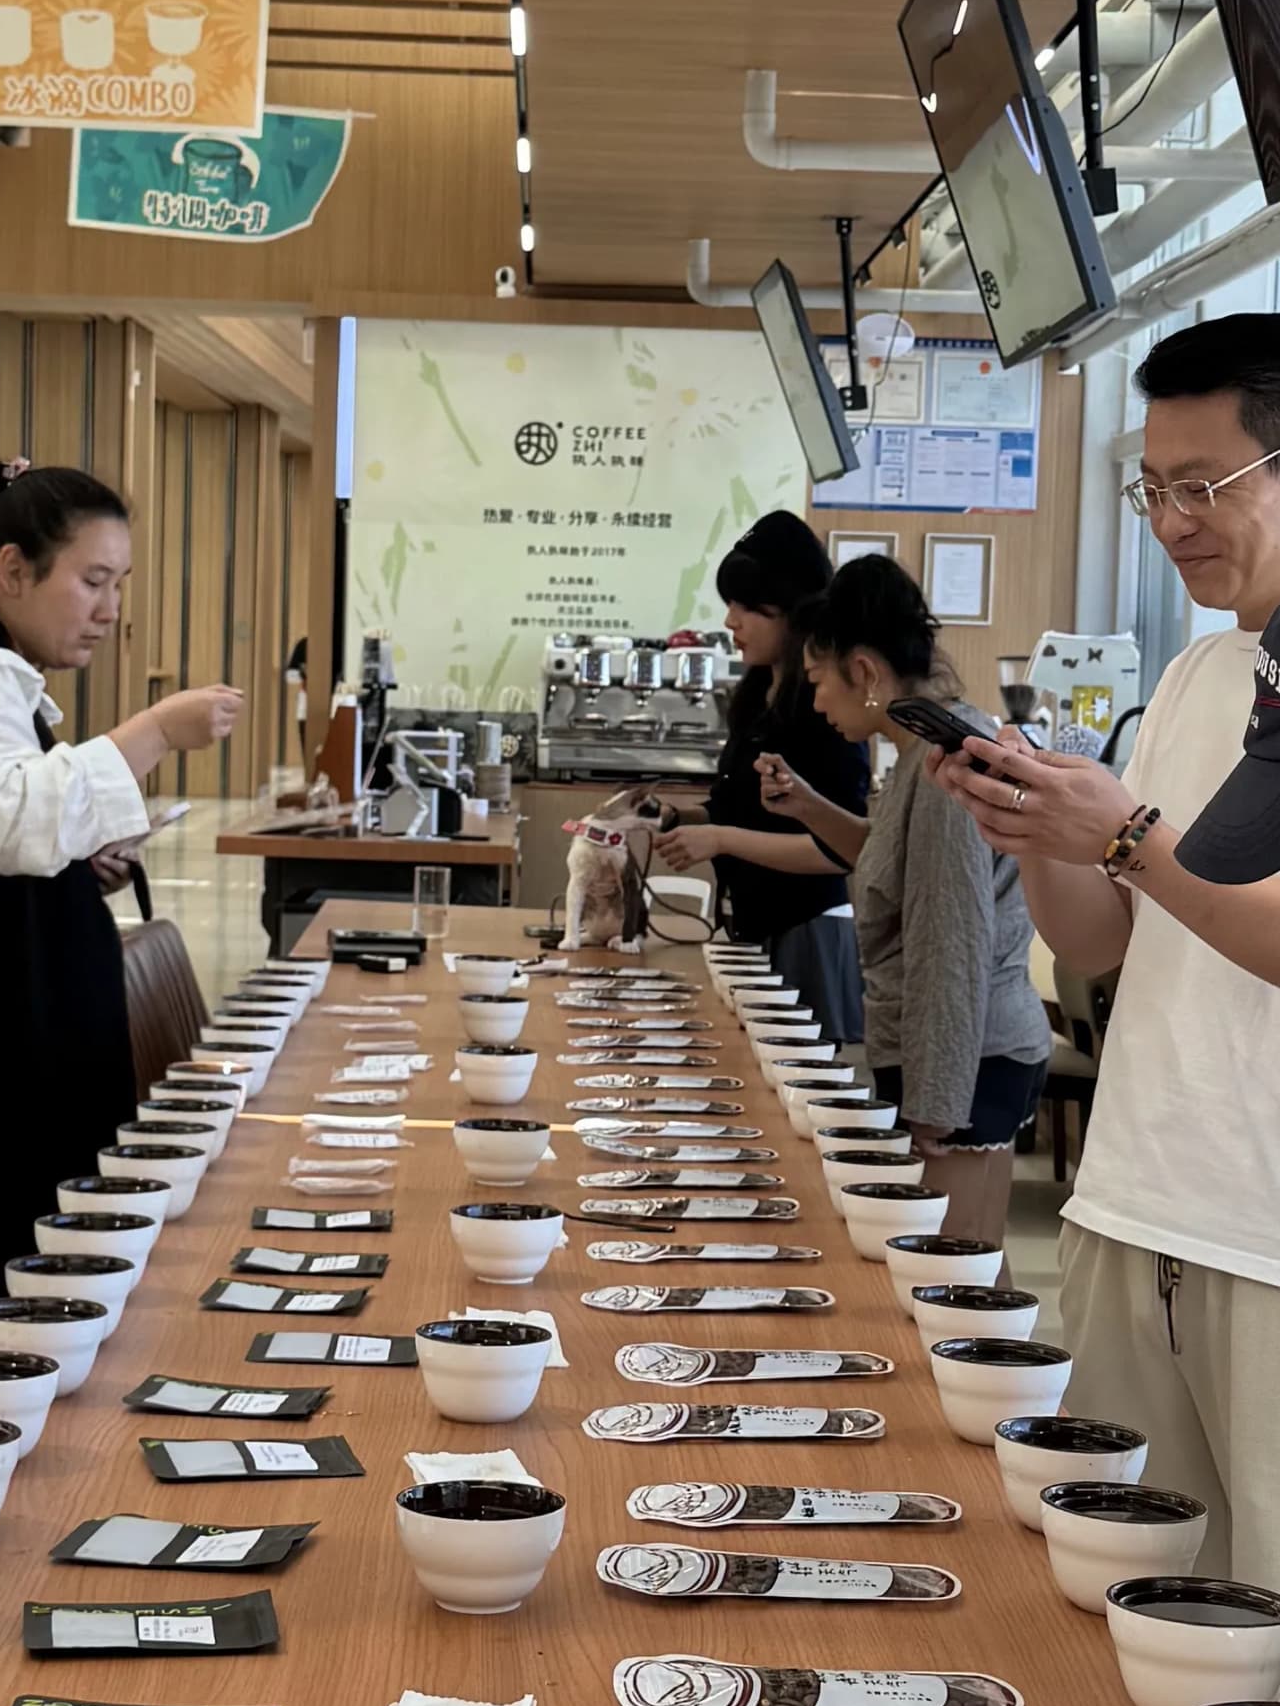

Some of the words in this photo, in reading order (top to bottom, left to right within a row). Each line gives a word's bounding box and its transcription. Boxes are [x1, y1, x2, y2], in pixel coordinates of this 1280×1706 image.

[7, 77, 192, 115] 冰滴COMBO
[572, 426, 646, 440] COFFEE
[572, 440, 603, 452] ZHI
